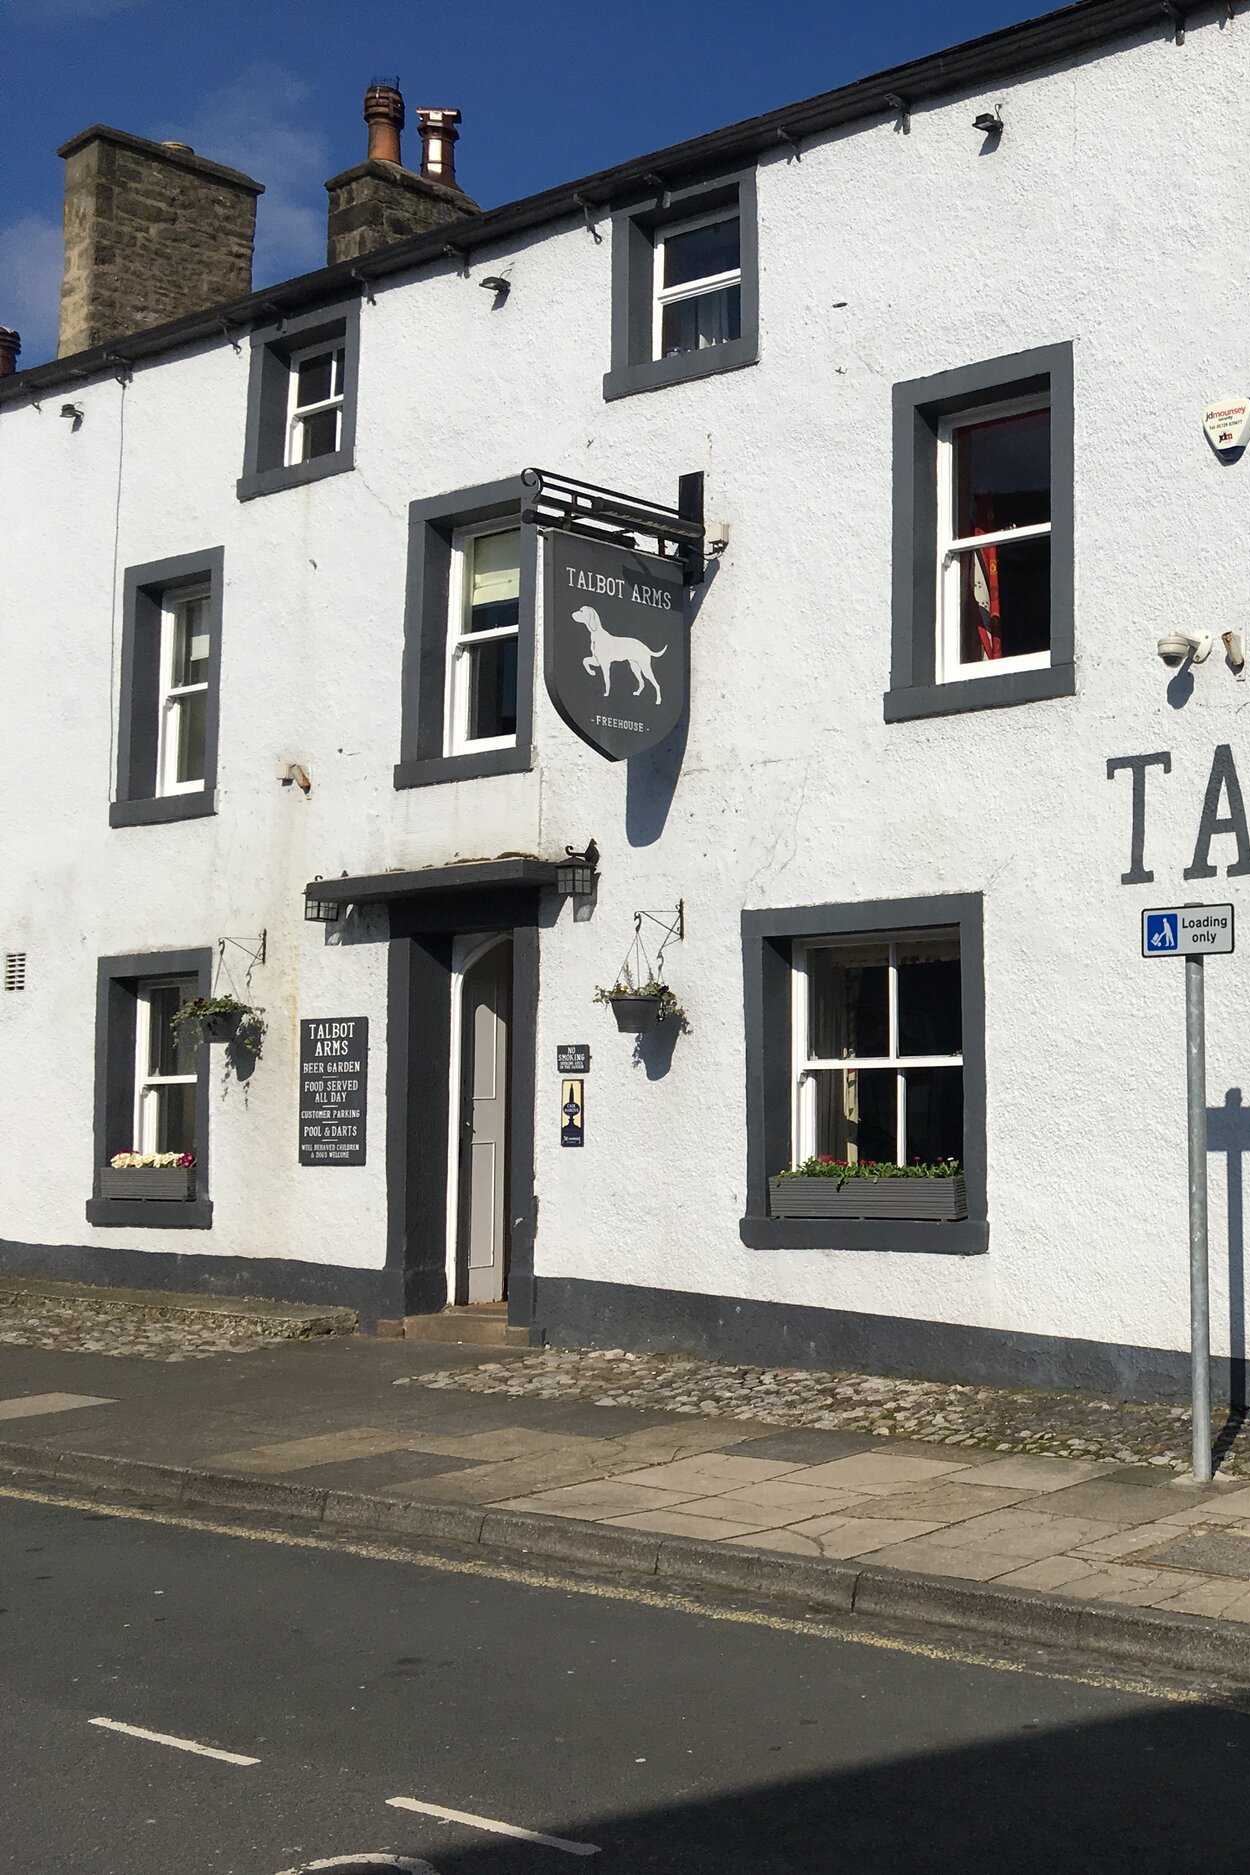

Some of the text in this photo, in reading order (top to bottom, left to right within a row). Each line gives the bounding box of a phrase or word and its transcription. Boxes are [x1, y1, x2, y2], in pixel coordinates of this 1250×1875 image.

[566, 566, 672, 610] TALBOT ARMS
[596, 715, 644, 732] FREEHOUSE
[1182, 916, 1228, 928] Loading
[1192, 930, 1216, 944] only
[308, 1022, 356, 1040] TALBOT
[314, 1040, 349, 1056] ARMS
[558, 1054, 585, 1062] SMOKING
[303, 1060, 360, 1074] BEER GARDEN
[304, 1080, 358, 1092] FOOD SERVED
[314, 1092, 347, 1102] ALL DAY
[301, 1110, 360, 1118] CUSTOMER PARKING
[304, 1126, 357, 1136] POOL & DARTS
